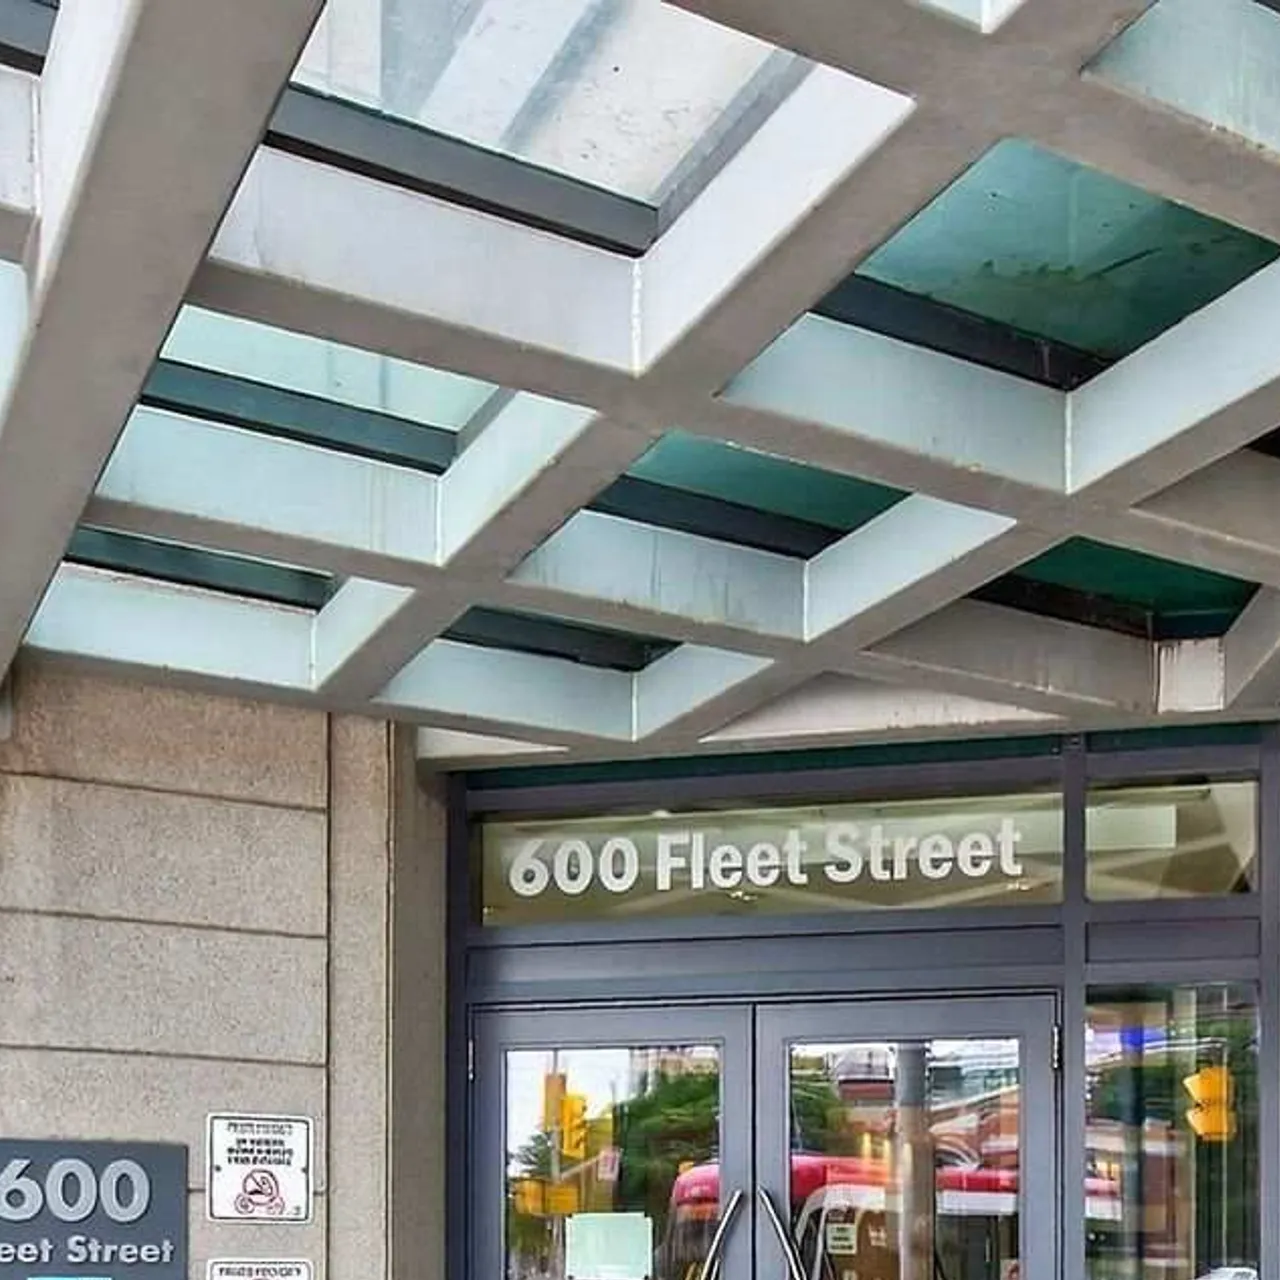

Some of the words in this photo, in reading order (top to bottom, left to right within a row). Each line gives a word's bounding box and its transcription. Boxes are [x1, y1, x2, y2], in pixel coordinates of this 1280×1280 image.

[508, 837, 640, 897] 600
[655, 827, 808, 892] Fleet
[823, 817, 1024, 884] Street
[67, 1233, 175, 1263] Street
